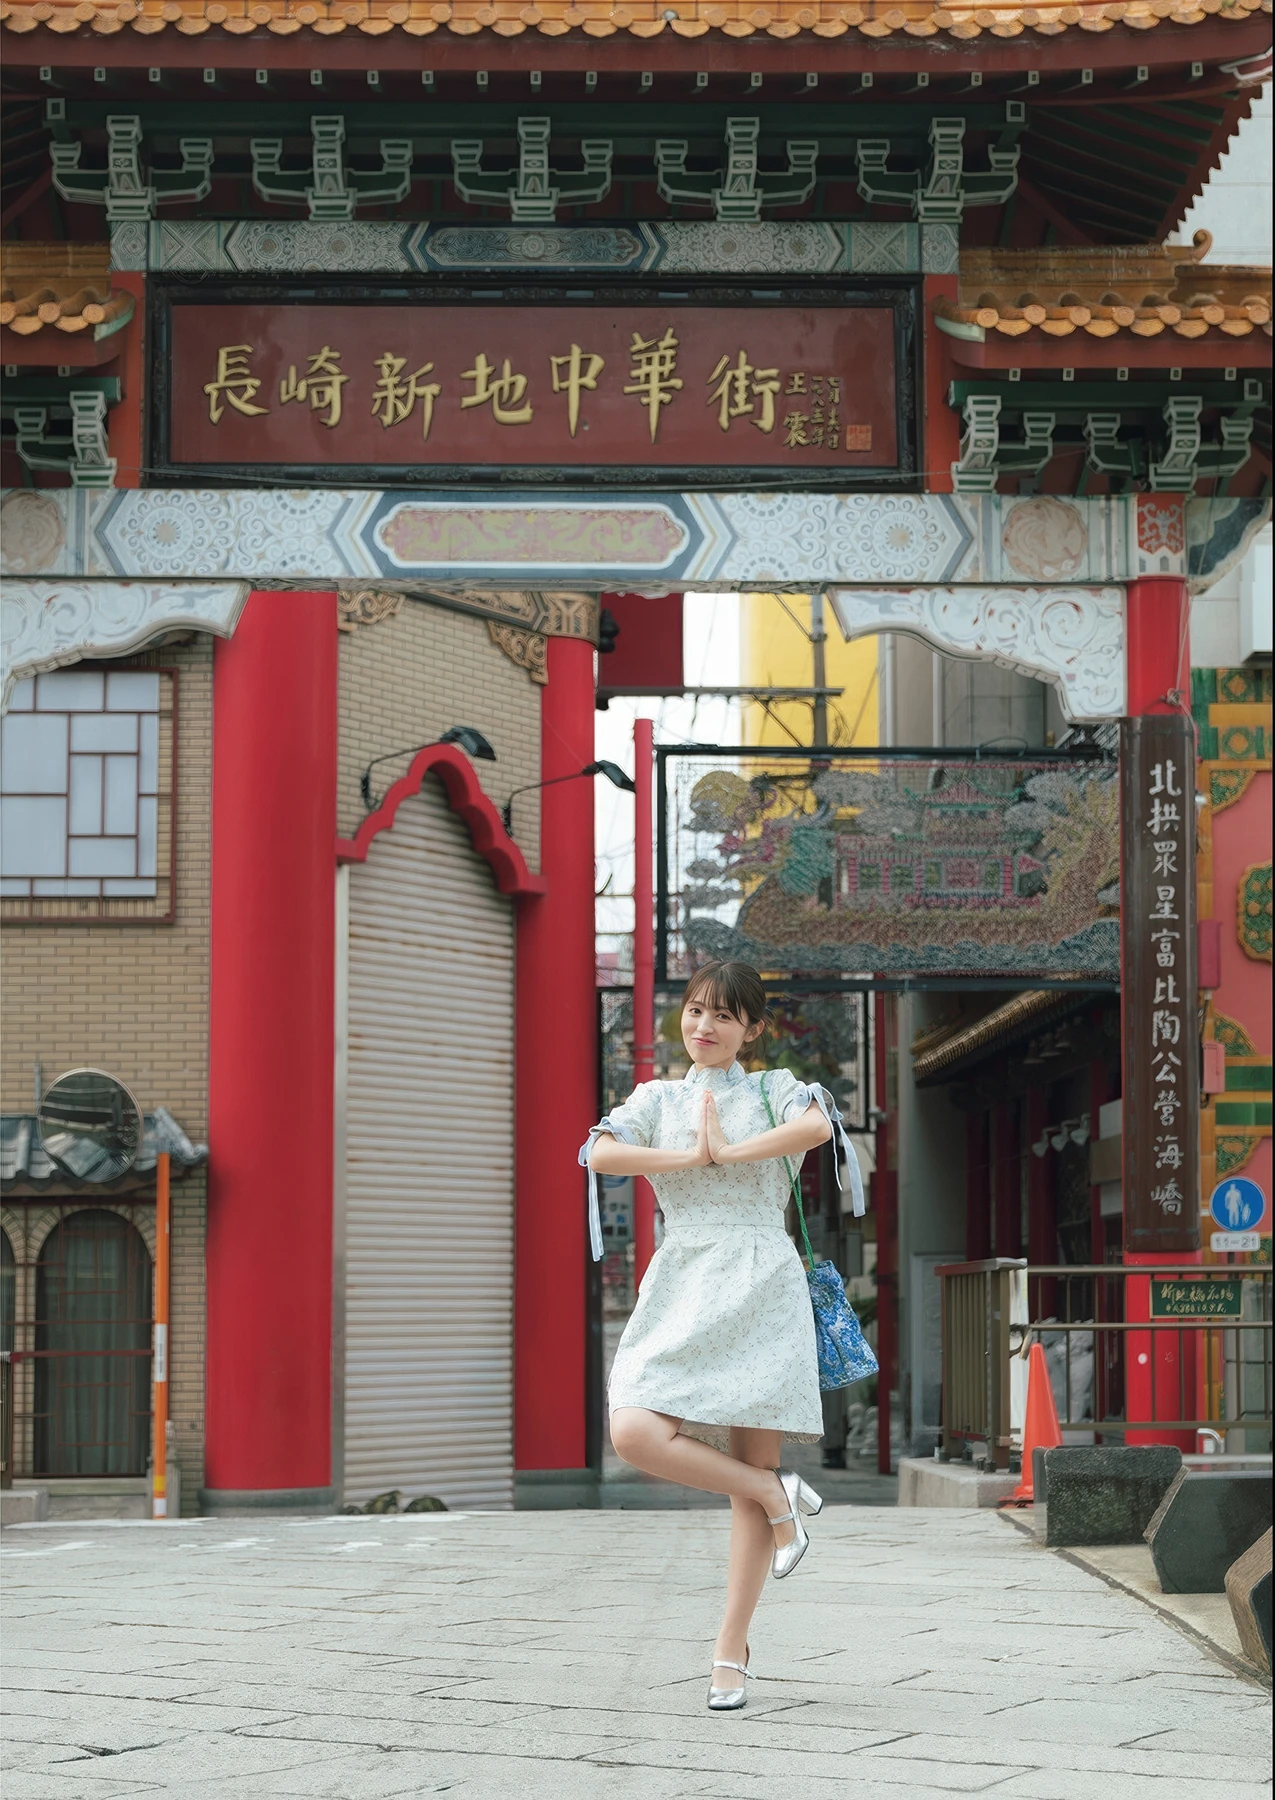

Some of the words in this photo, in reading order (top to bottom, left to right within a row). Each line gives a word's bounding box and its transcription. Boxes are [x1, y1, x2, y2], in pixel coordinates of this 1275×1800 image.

[204, 327, 781, 443] 長崎新地中華街
